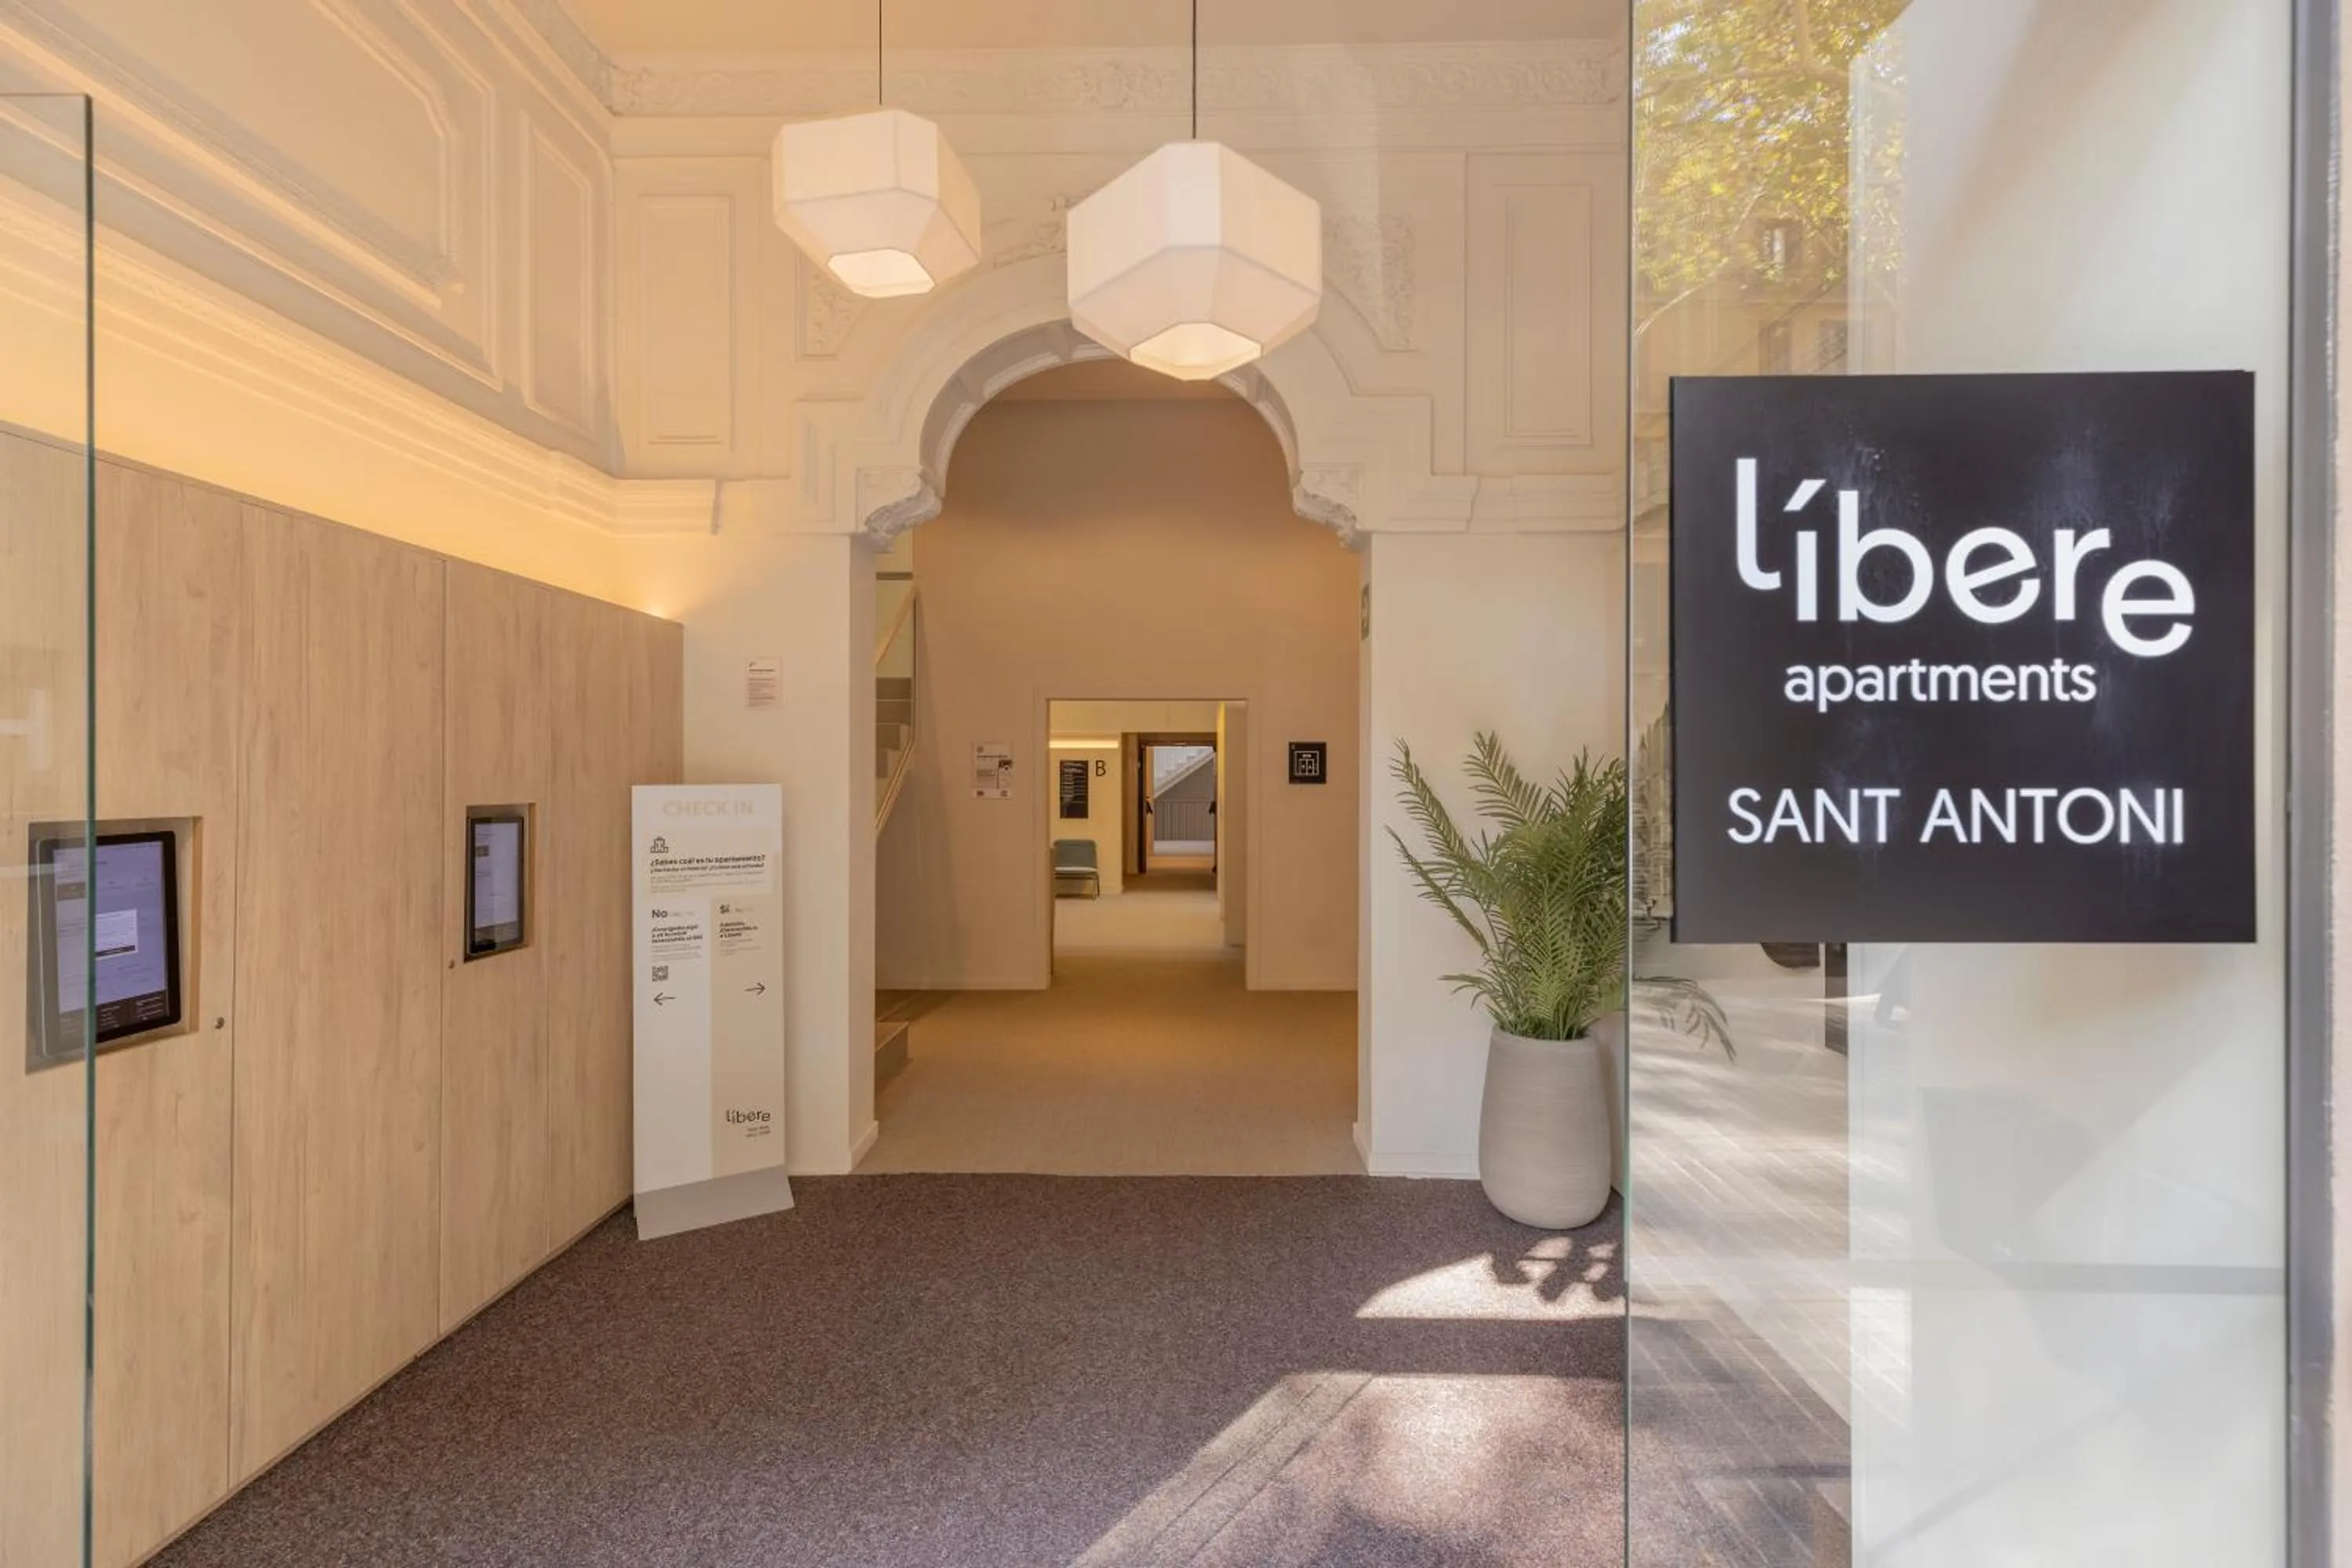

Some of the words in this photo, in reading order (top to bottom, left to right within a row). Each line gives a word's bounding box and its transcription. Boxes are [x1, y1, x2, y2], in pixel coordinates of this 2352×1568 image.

[1737, 458, 2196, 657] líbere
[1784, 657, 2096, 712] apartments
[1095, 760, 1106, 777] B
[662, 800, 728, 817] CHECK
[733, 799, 754, 816] IN
[1728, 788, 1900, 843] SANT
[1921, 788, 2183, 844] ANTONI
[652, 909, 668, 918] No
